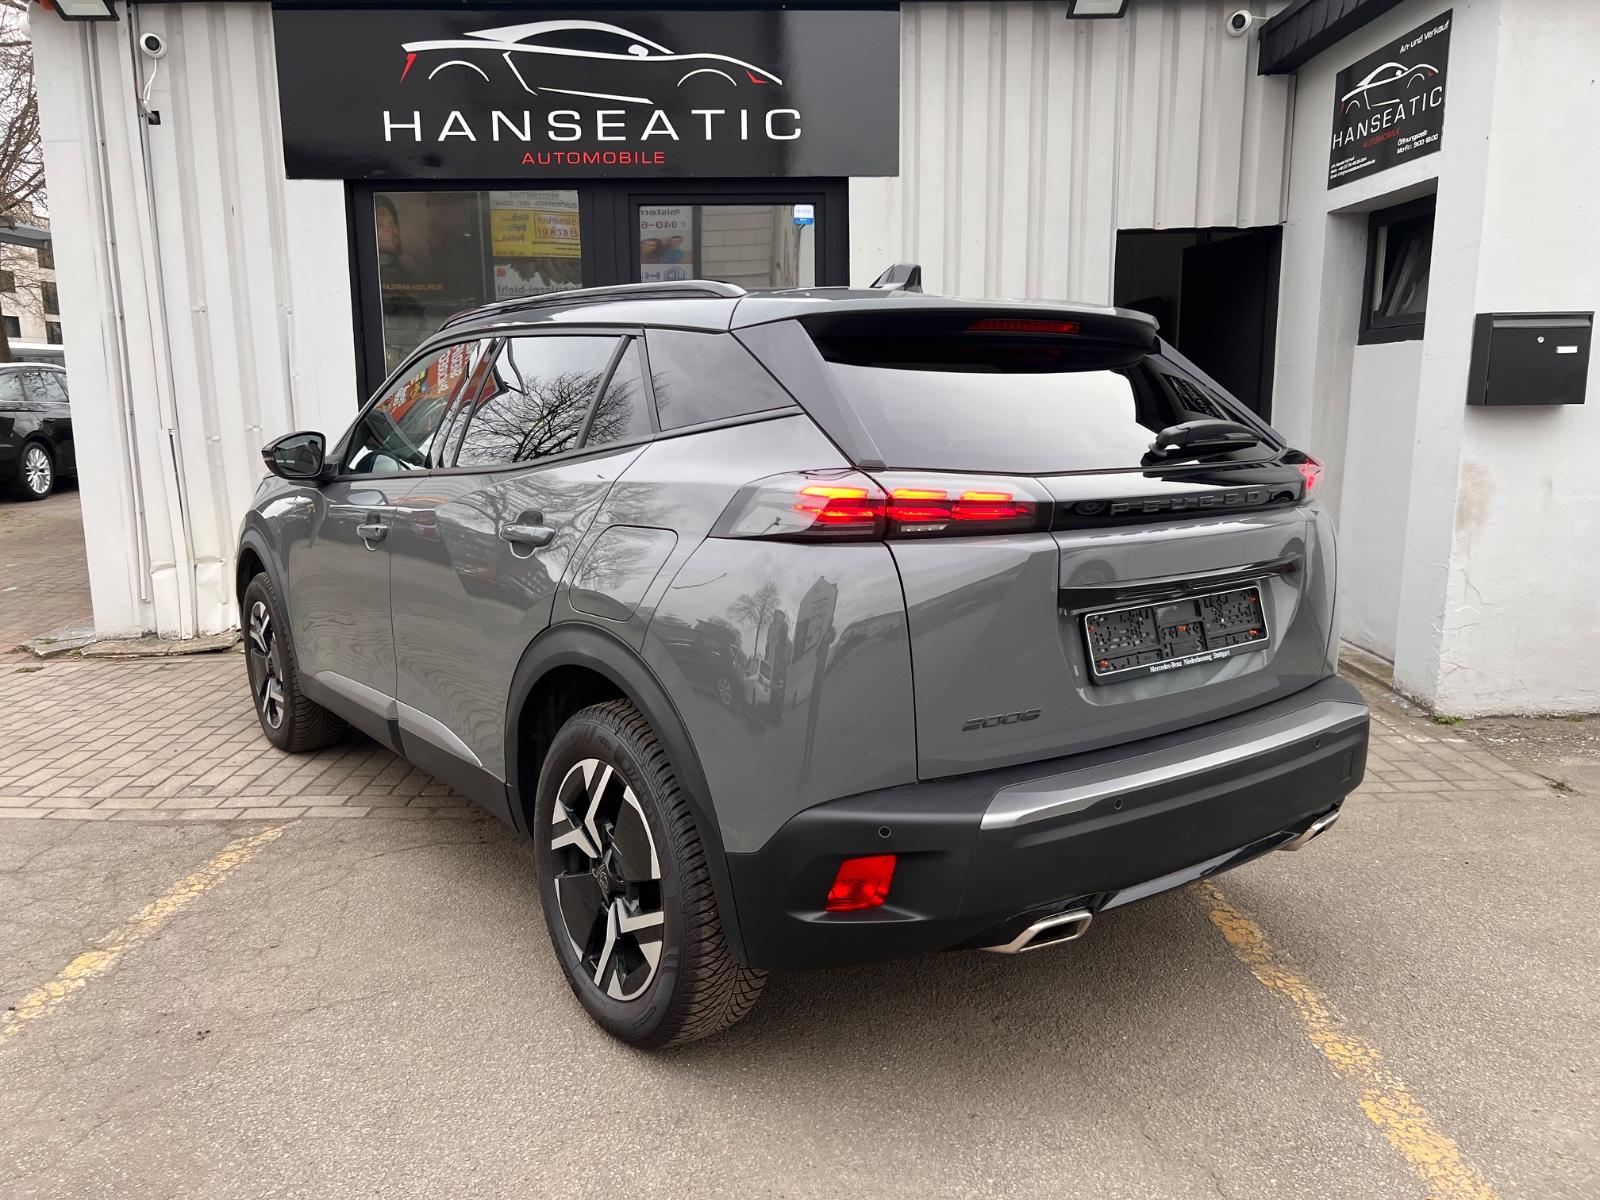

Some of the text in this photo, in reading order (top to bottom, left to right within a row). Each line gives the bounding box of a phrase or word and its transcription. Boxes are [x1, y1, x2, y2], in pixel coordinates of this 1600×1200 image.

[1410, 33, 1424, 48] und
[1423, 19, 1450, 41] Verkauf
[383, 108, 802, 142] HANSEATIC
[1332, 86, 1443, 150] HANSEATIC
[521, 151, 665, 165] AUTOMOBILE
[1110, 489, 1279, 516] PEUGEOT
[1149, 660, 1183, 673] Mercedes-Benz
[1212, 650, 1230, 660] Stuttgart
